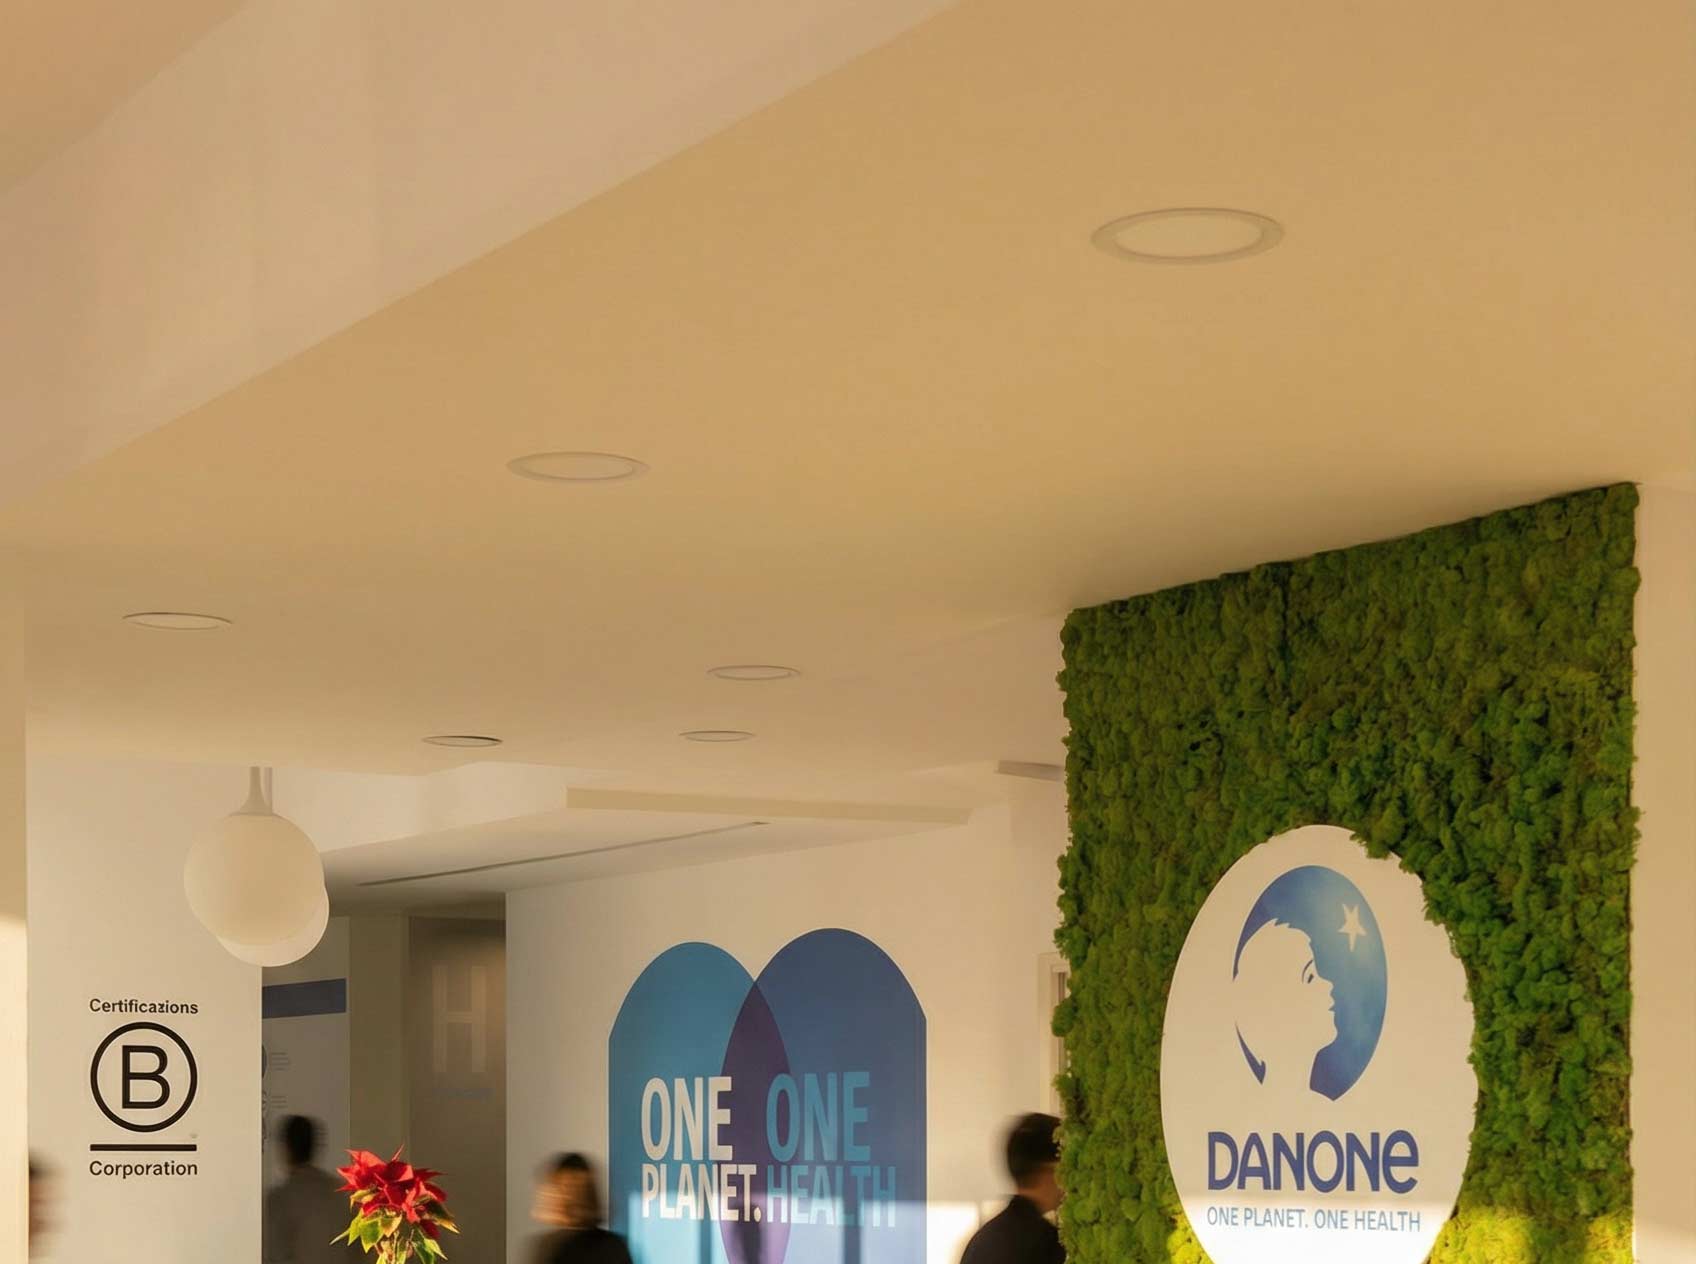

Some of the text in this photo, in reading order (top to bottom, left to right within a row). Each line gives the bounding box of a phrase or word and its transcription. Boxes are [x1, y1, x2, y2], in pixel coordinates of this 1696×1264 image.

[121, 1044, 171, 1109] B
[641, 1075, 733, 1161] ONE
[766, 1071, 871, 1163] ONE
[89, 1160, 198, 1179] Corporation
[641, 1163, 762, 1222] PLANET.
[767, 1164, 897, 1228] HEALTH
[1207, 1206, 1421, 1232] ONE PLANET. ONE HEALTH
